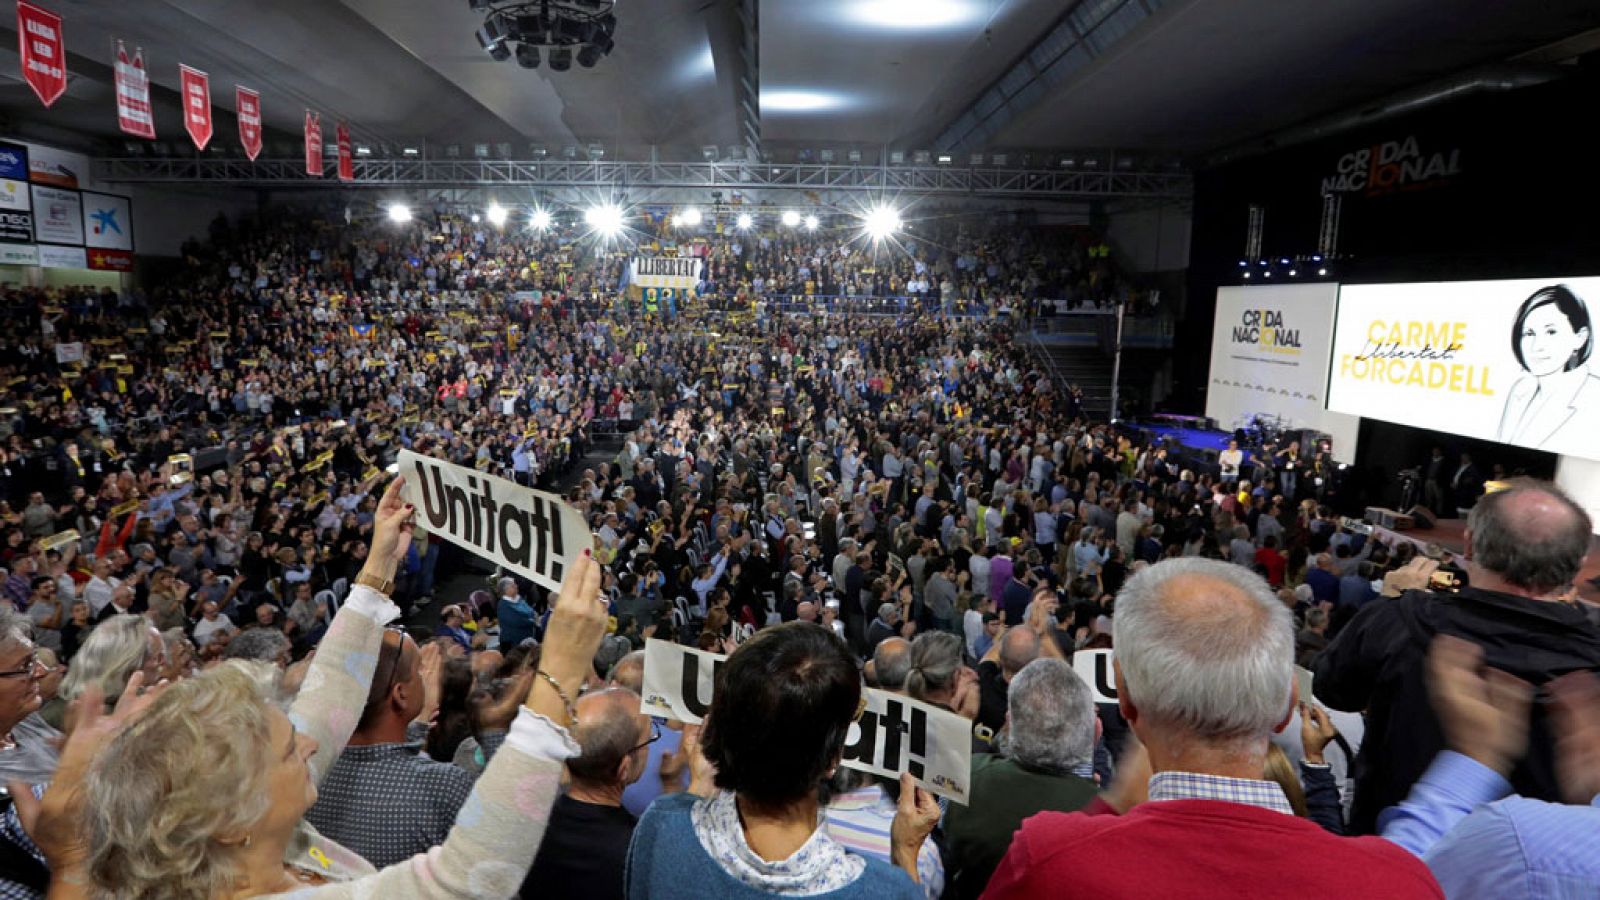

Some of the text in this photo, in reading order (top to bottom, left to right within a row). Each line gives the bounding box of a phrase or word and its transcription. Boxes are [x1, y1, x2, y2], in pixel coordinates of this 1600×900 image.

[1242, 309, 1283, 328] CRIDA
[1232, 326, 1301, 347] NACIONAL
[1367, 319, 1467, 351] CARME
[1340, 354, 1496, 396] FORCADELL
[415, 460, 564, 583] Unitat!
